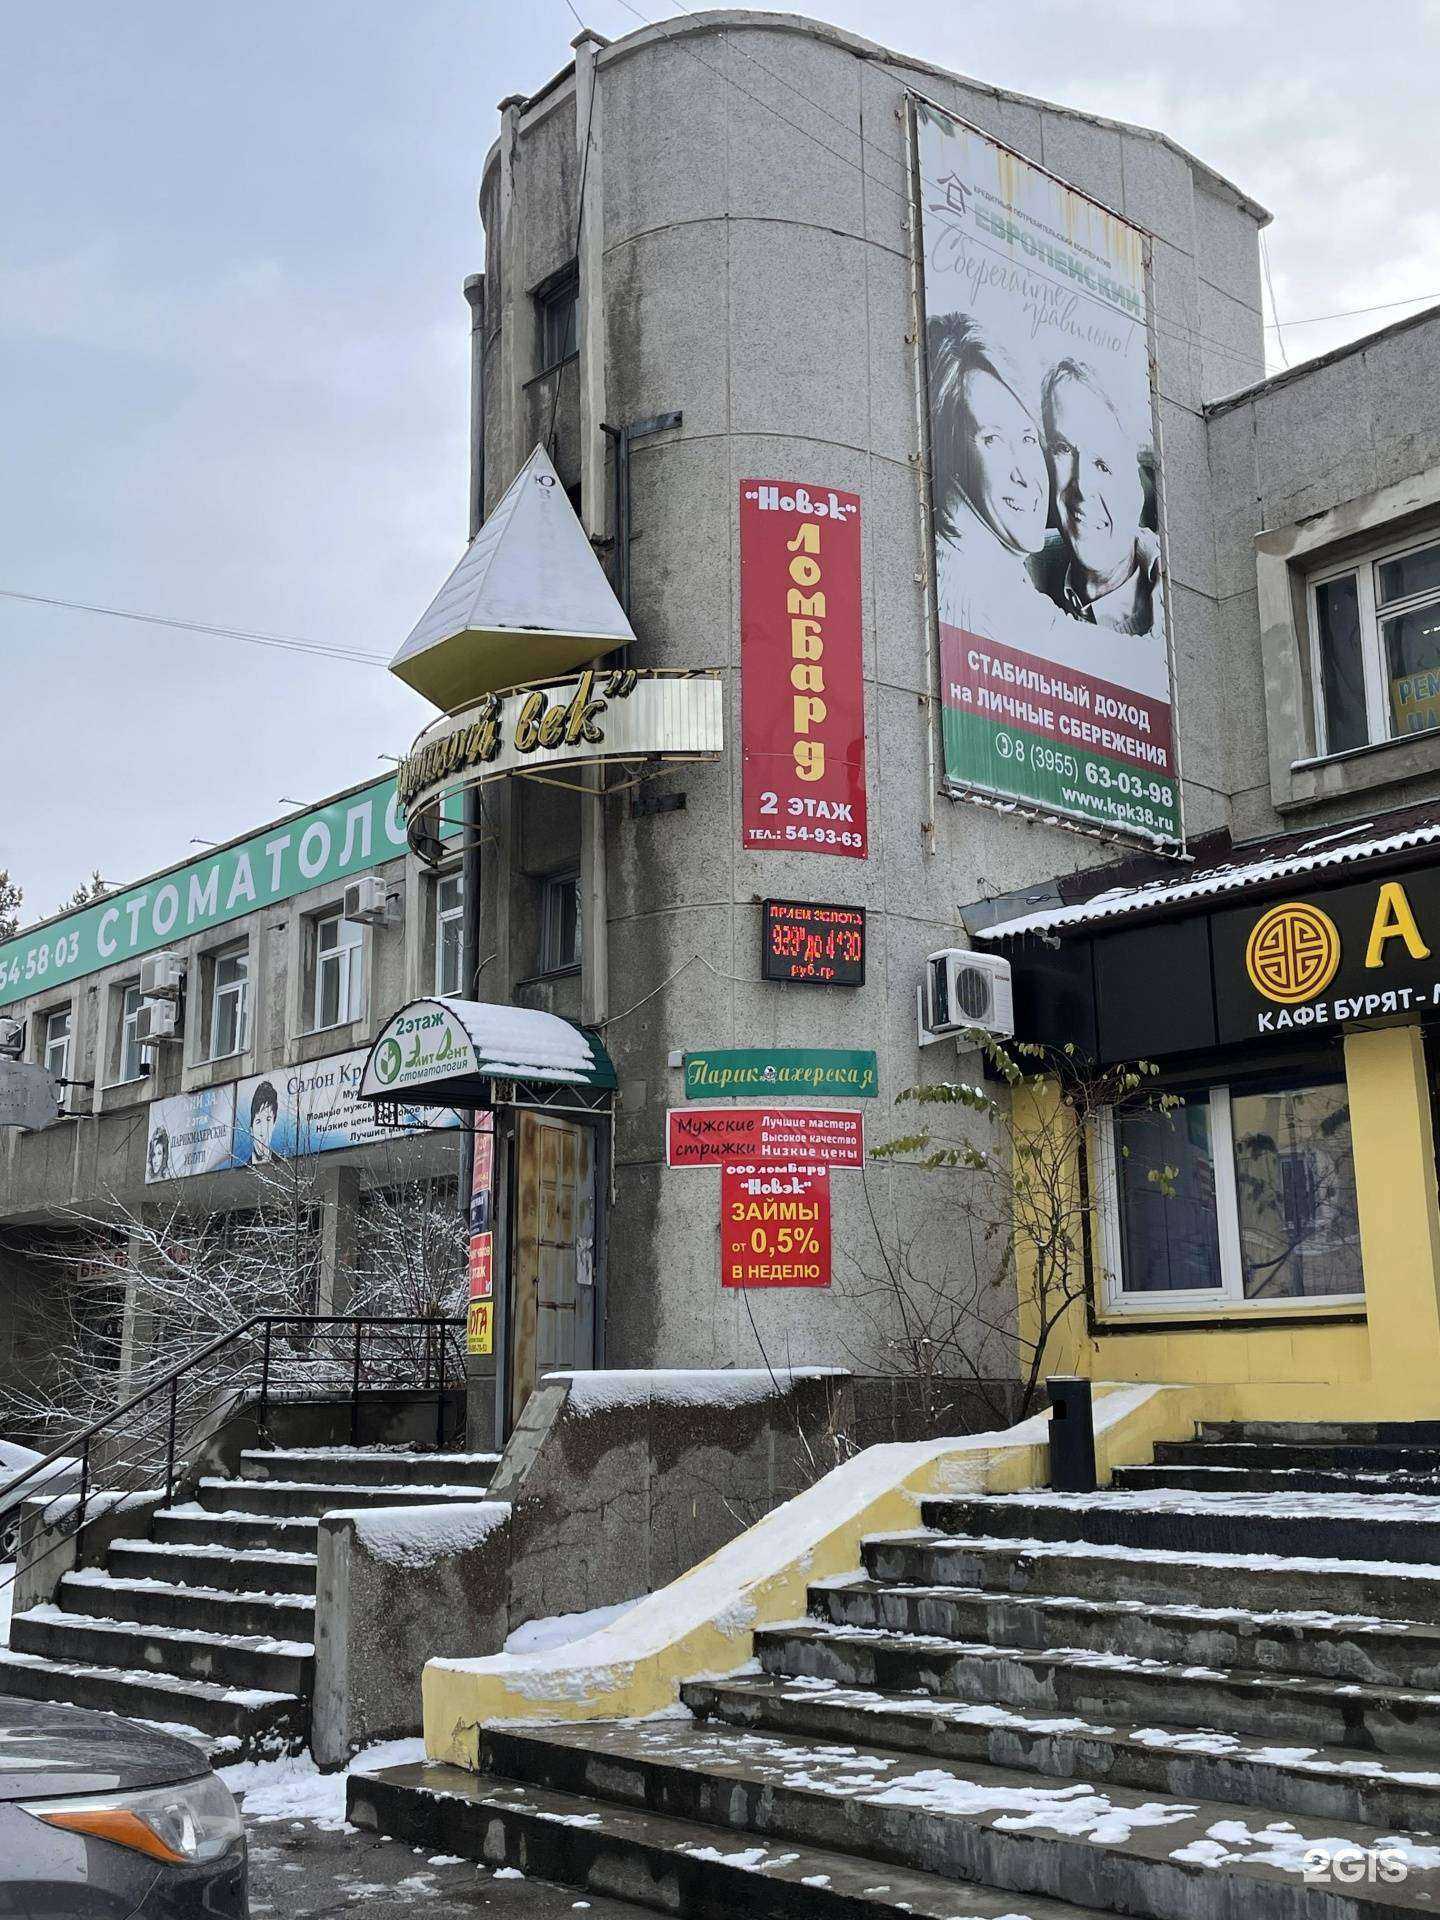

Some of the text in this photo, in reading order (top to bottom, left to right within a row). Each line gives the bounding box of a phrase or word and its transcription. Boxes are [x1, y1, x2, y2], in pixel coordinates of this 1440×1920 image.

[967, 650, 1151, 733] СТАБИЛЬНЫЙ ДОХОД
[950, 683, 1167, 767] на ЛИЧНЫЕ СБЕРЕЖЕНИЯ
[1015, 739, 1174, 808] 8 (3955) 63-03-98
[759, 791, 853, 823] 2 ЭТАЖ
[1061, 786, 1174, 831] www.kpk38.ru
[785, 825, 863, 848] 54-93-63
[1257, 1003, 1329, 1032] КАФЕ
[287, 1063, 362, 1095] Салон Кр
[400, 1060, 468, 1082] стоматология
[343, 1102, 374, 1118] мужск
[316, 1121, 348, 1134] Низкие
[349, 1128, 386, 1141] Лучшие
[677, 1115, 857, 1136] Мужские Лучшие мастера
[761, 1131, 857, 1146] Высокое качество
[675, 1143, 857, 1160] стрижки Низкие цены
[731, 1198, 819, 1221] ЗАЙМЫ
[751, 1227, 820, 1258] 0,5%
[732, 1264, 820, 1280] В НЕДЕЛЮ
